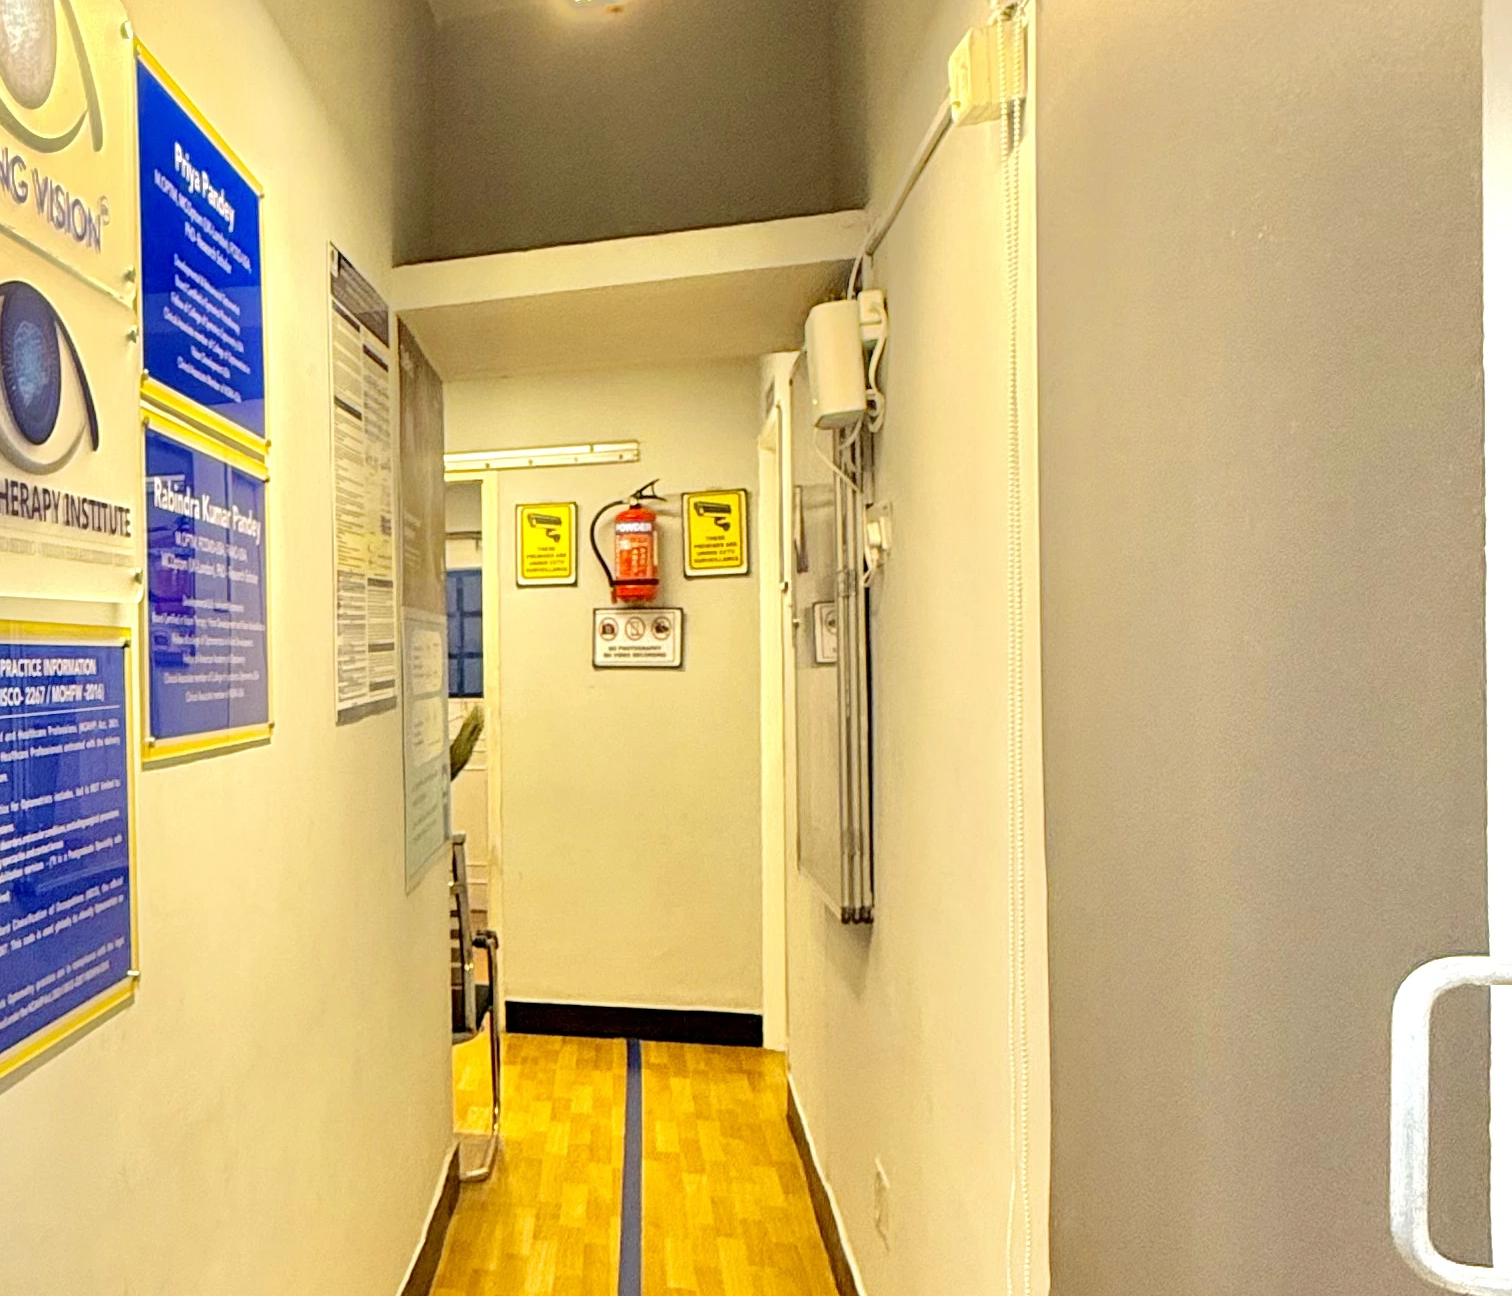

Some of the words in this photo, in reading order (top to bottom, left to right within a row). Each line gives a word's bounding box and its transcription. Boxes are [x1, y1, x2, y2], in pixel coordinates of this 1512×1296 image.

[31, 167, 102, 253] VISION
[174, 141, 201, 193] Priya
[201, 171, 235, 232] Pandey
[63, 493, 131, 538] INSTITUTE
[154, 477, 200, 519] Rabindra
[202, 493, 231, 528] Kumar
[232, 505, 261, 546] Pandey
[0, 659, 42, 677] PRACTICE
[43, 658, 96, 676] INFORMATION
